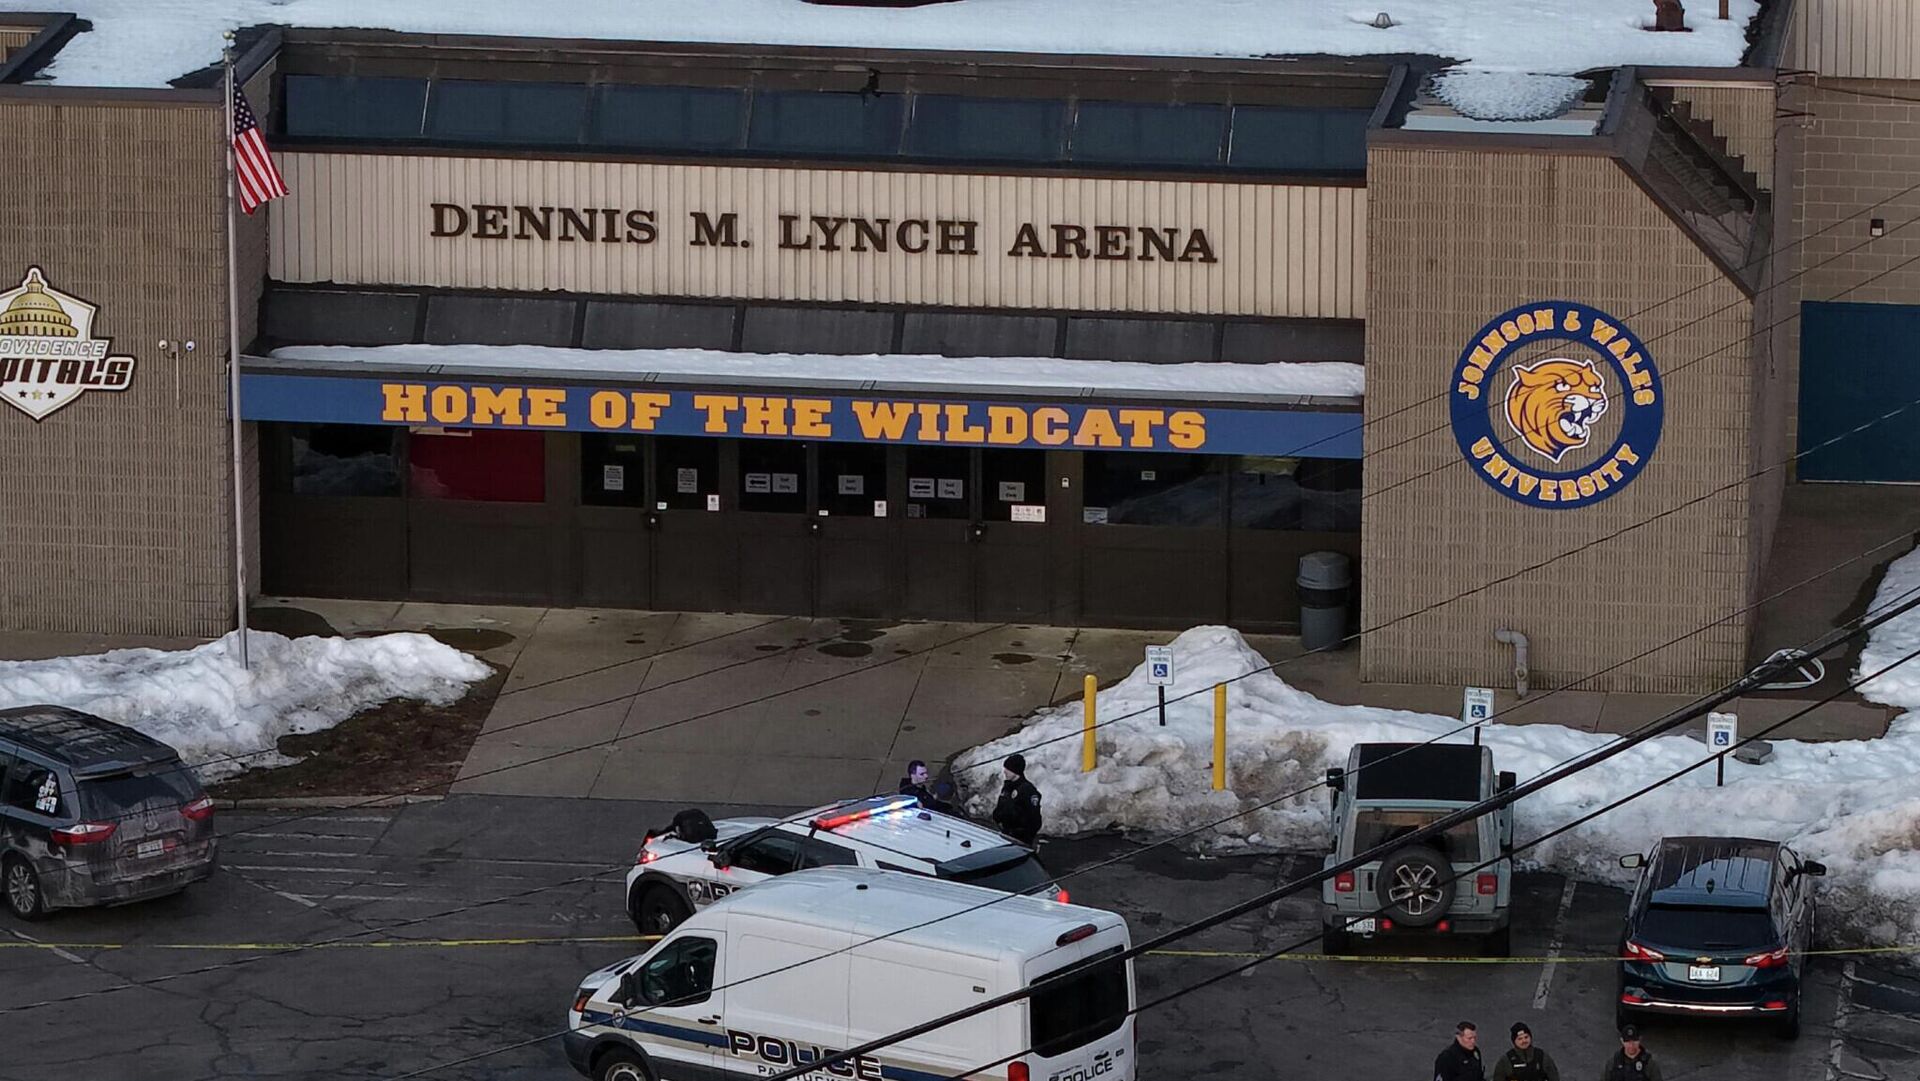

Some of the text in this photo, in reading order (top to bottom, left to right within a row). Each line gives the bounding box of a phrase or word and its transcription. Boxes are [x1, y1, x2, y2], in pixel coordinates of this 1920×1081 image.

[429, 202, 1218, 264] DENNIS M. LYNCH ARENA
[1458, 308, 1657, 407] JOHNSON & WALES
[381, 382, 1207, 450] HOME OF THE WILDCATS
[1470, 436, 1641, 502] UNIVERSITY
